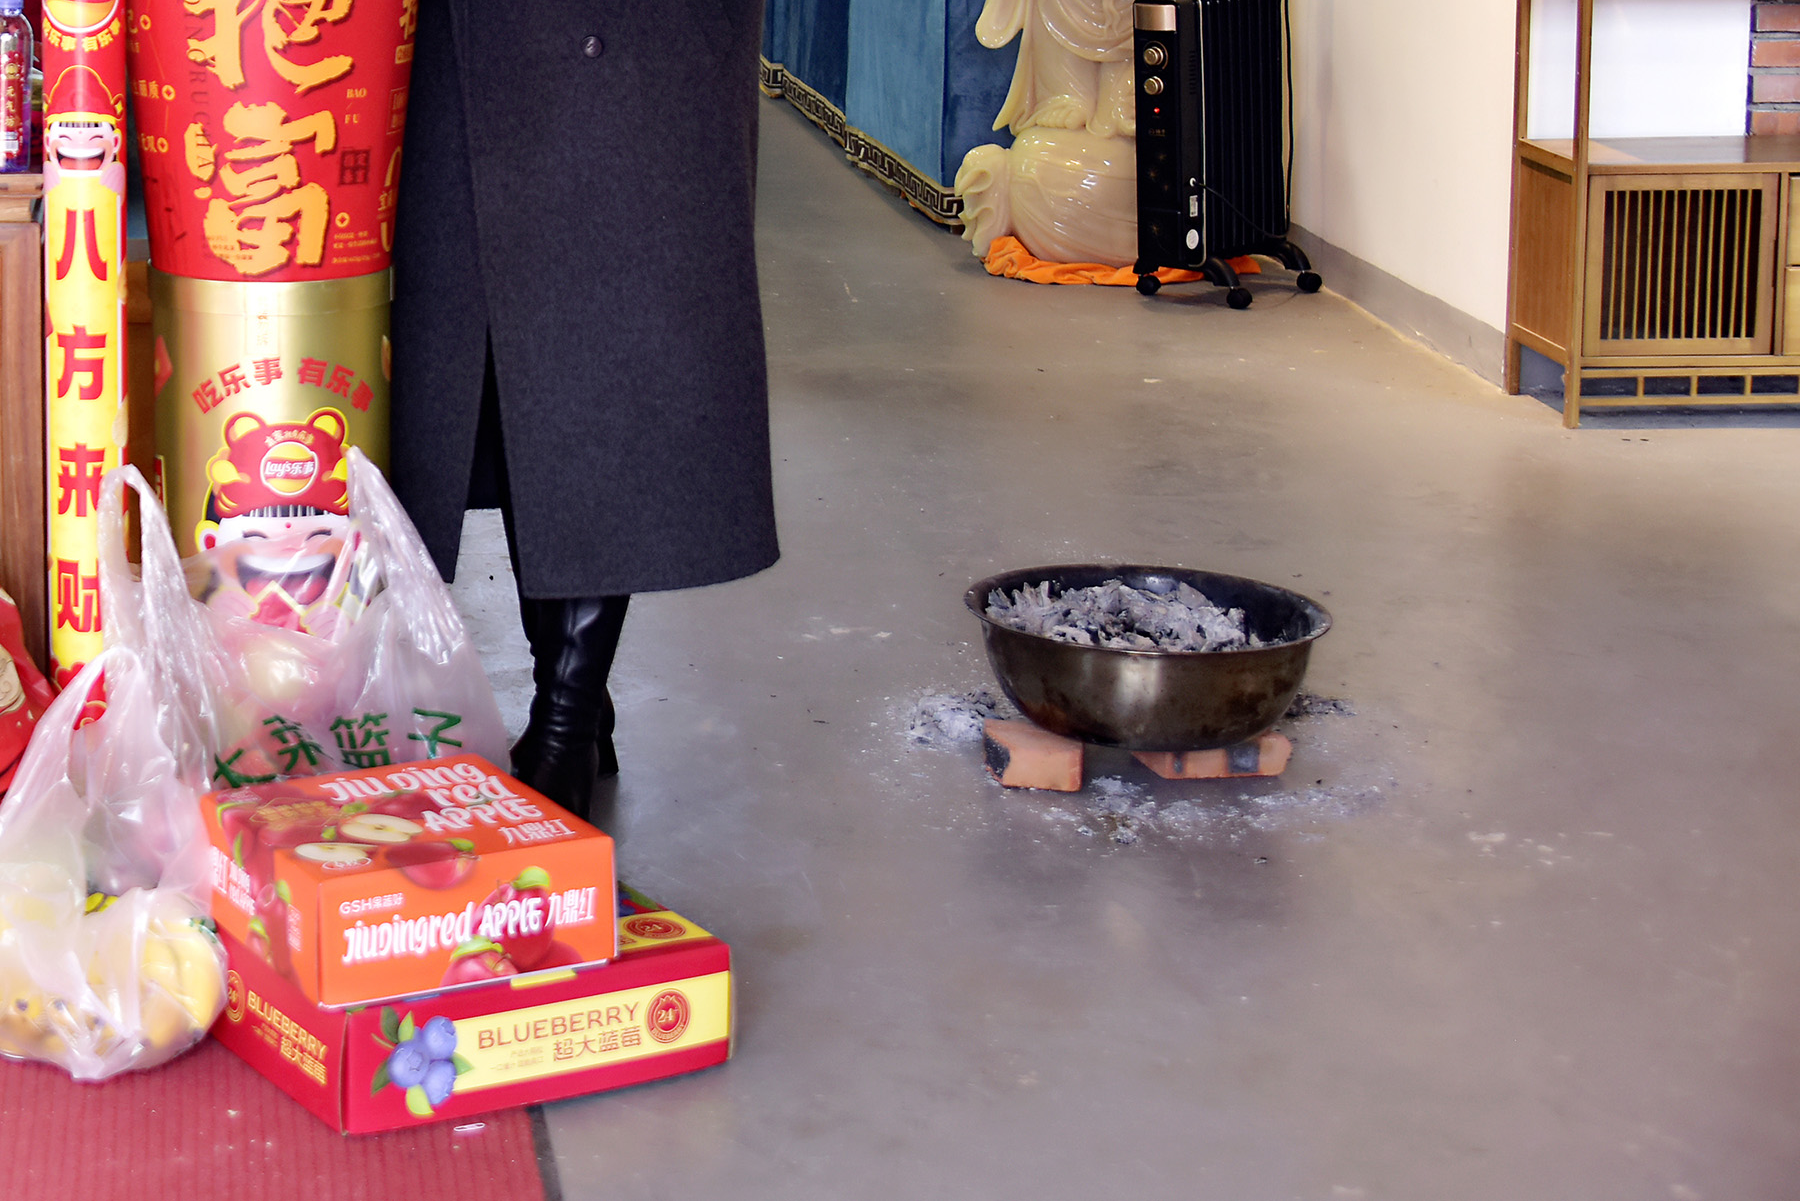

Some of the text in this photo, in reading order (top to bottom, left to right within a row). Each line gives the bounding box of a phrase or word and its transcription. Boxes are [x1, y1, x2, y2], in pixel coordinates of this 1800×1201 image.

[346, 87, 367, 99] BAO
[344, 113, 360, 124] FU
[192, 356, 376, 415] 吃乐事 有乐事
[55, 208, 108, 634] 八方来财
[264, 460, 315, 478] Lay's乐事
[497, 818, 576, 845] 九鼎红
[545, 886, 597, 927] 九鼎红
[247, 989, 328, 1061] BLUEBERRY
[478, 1001, 640, 1049] BLUEBERRY
[553, 1025, 642, 1062] 超大蓝莓
